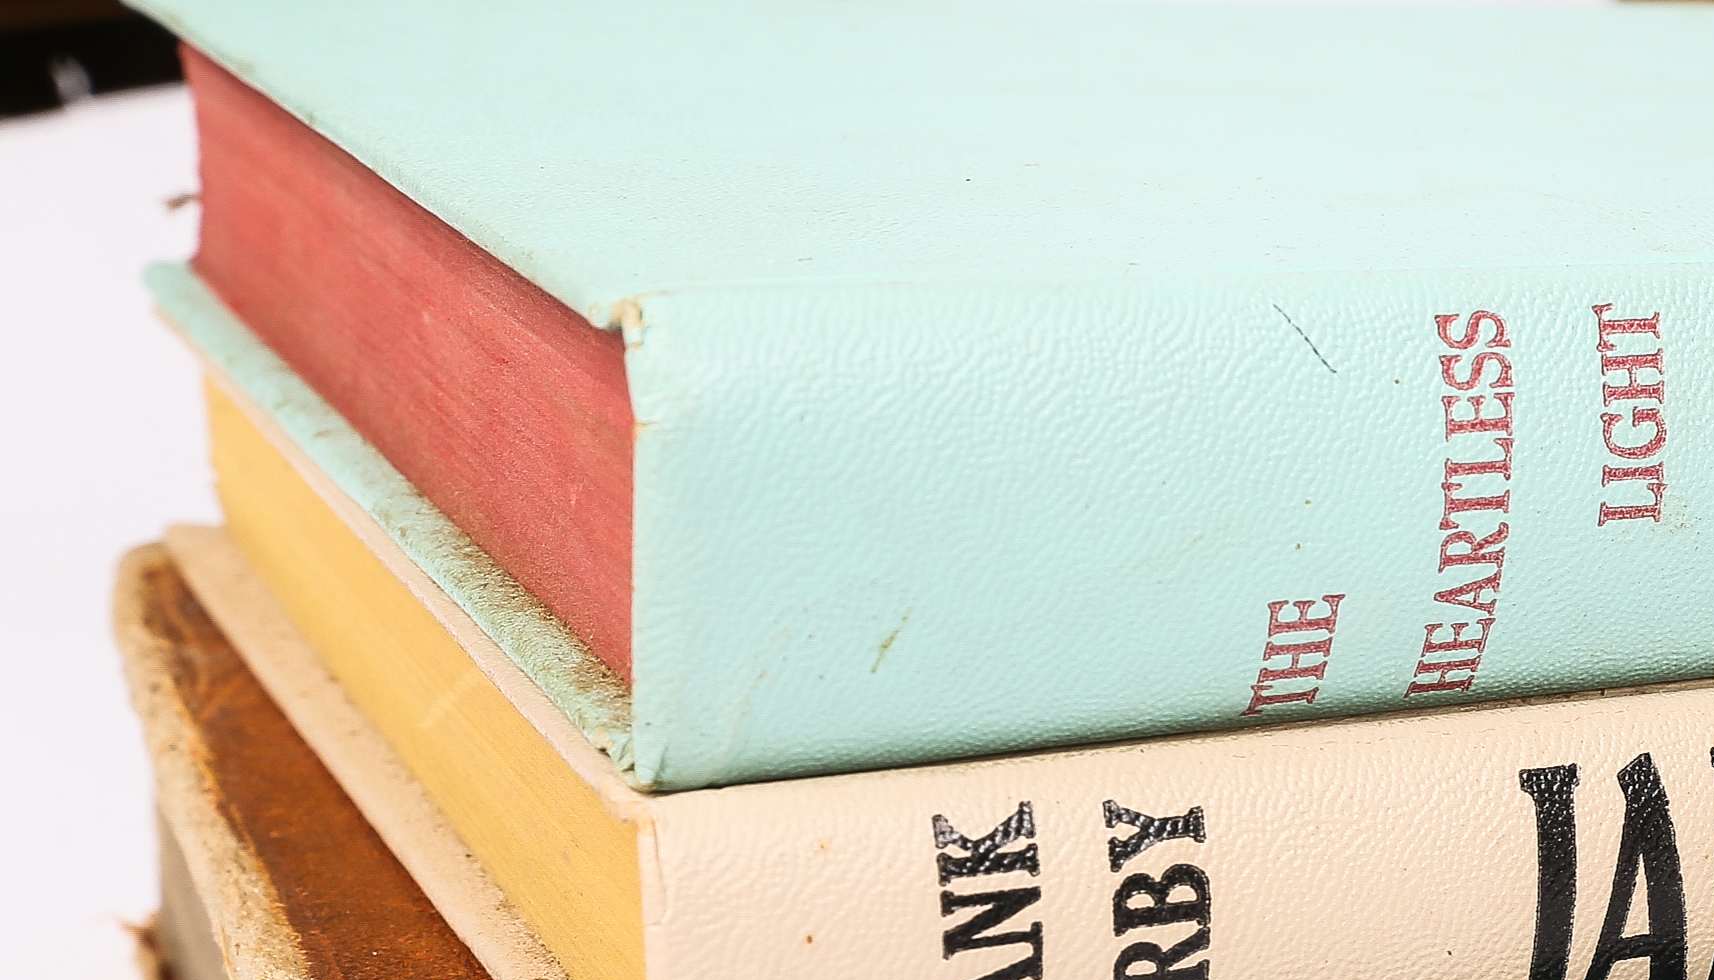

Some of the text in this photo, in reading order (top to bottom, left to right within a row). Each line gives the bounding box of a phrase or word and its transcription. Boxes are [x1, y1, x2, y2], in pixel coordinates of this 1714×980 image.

[1405, 308, 1515, 698] HEARTLESS
[1592, 302, 1667, 527] LIGHT
[1240, 593, 1346, 717] THE
